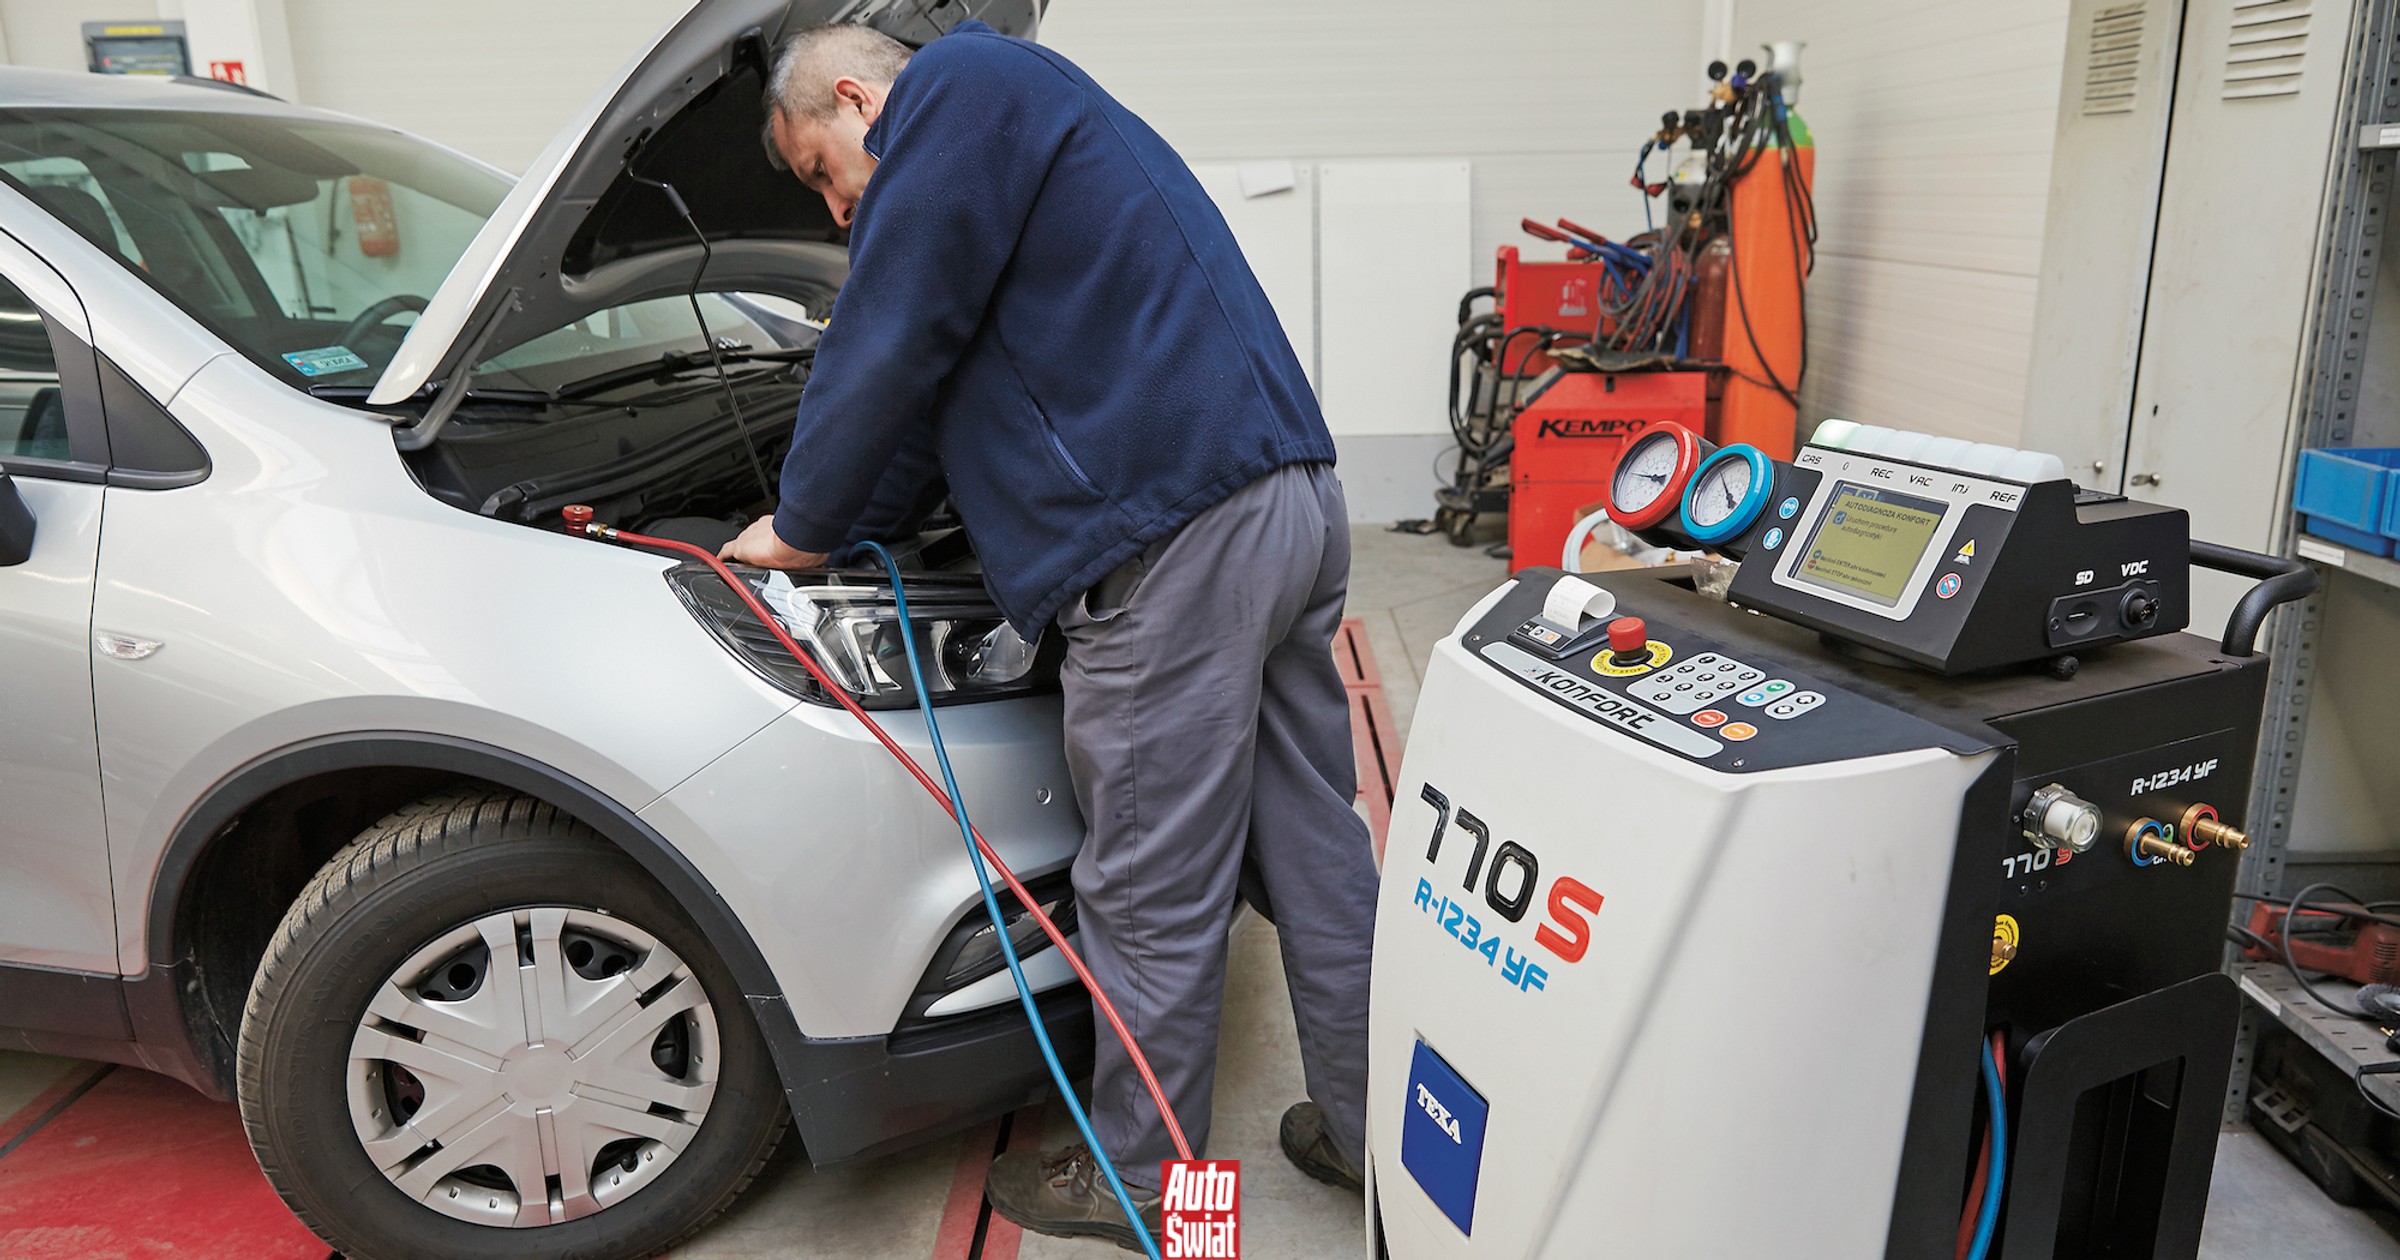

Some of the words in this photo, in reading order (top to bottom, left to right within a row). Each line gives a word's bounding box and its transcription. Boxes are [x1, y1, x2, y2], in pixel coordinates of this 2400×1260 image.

[1870, 467, 1893, 479] REC
[1909, 475, 1933, 487] VAC
[1951, 483, 1970, 495] INJ
[1990, 490, 2018, 503] REF
[1844, 501, 1896, 519] AUTODIAGNOZA
[1896, 511, 1931, 527] KONFORT
[2121, 560, 2149, 577] VDC
[2075, 570, 2094, 586] SD
[1416, 1082, 1462, 1145] TEXA
